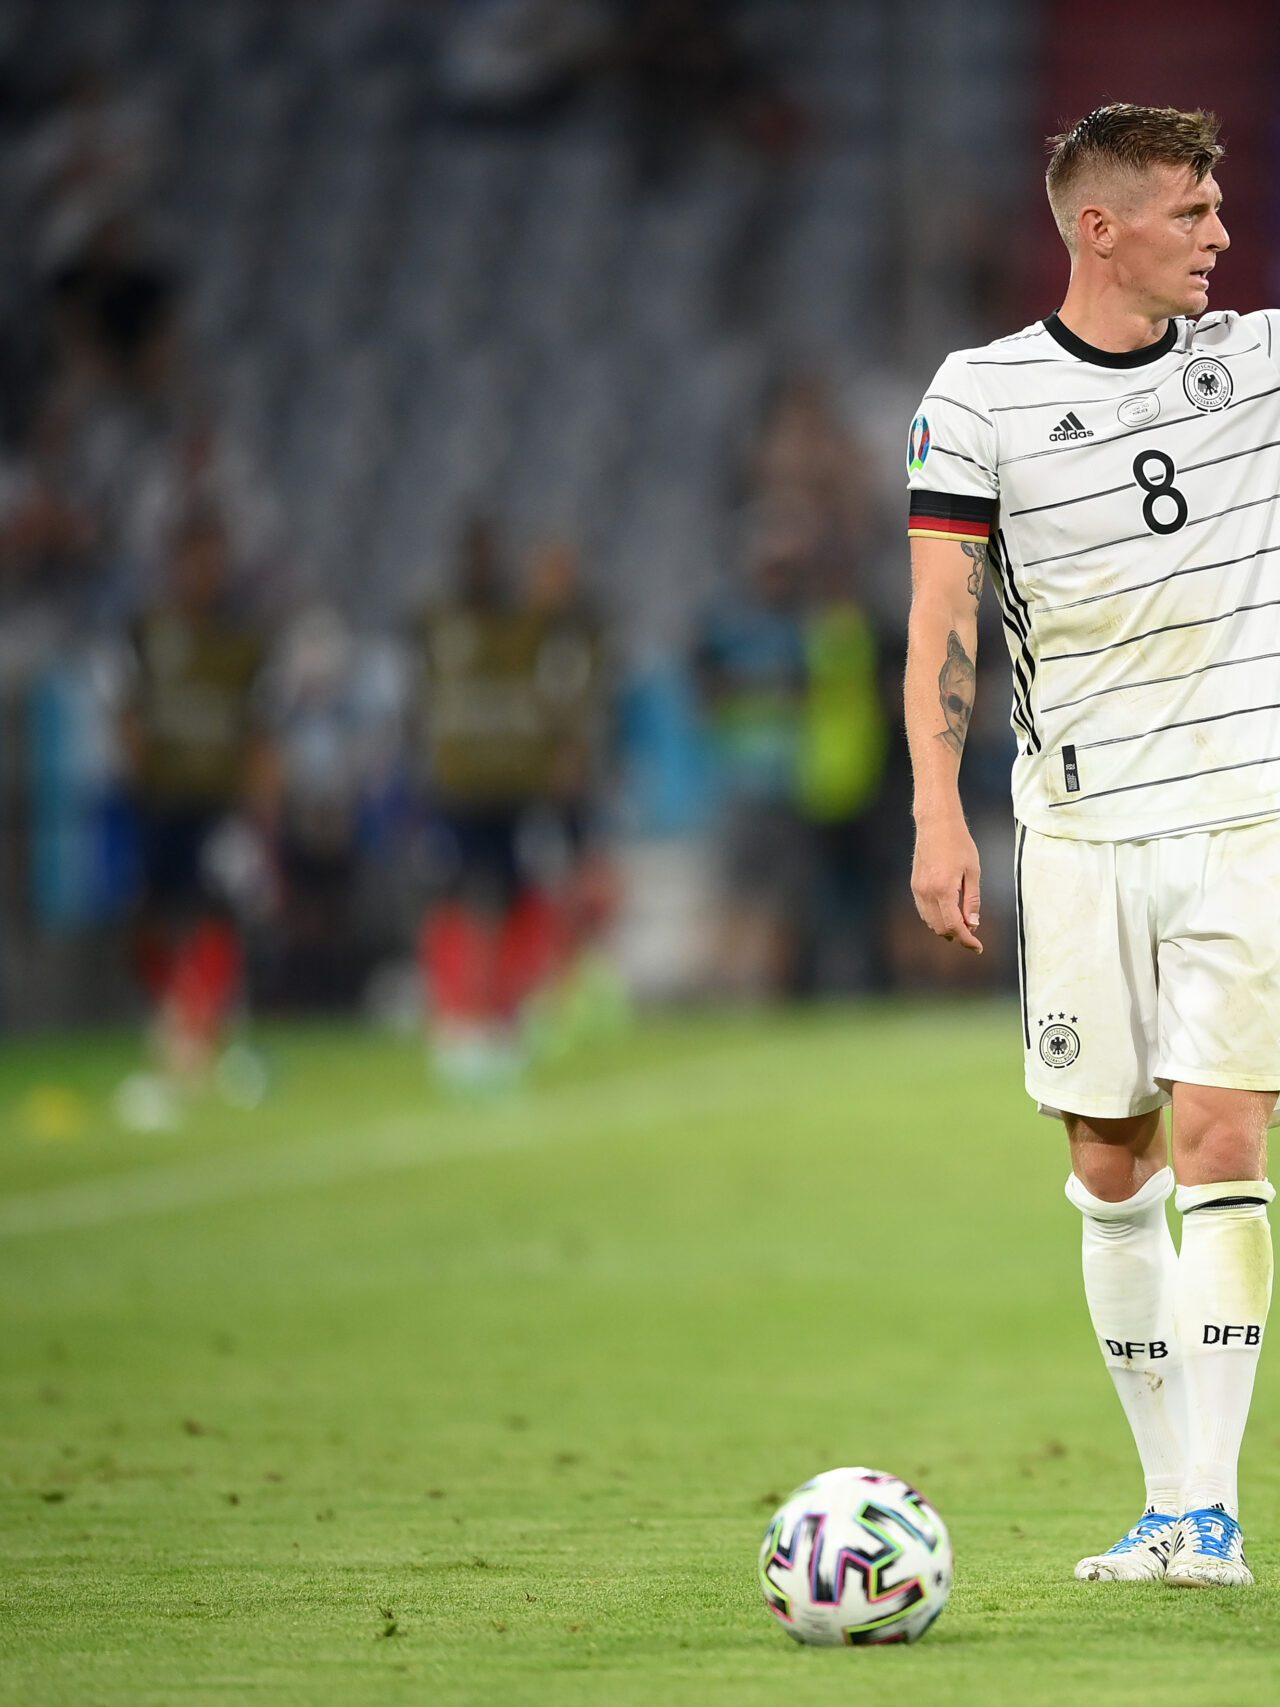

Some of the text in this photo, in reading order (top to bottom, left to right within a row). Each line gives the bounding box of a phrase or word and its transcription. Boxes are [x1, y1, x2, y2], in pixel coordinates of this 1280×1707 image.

[1191, 363, 1218, 378] DEUTSCHER
[1049, 430, 1094, 442] adidas
[1133, 450, 1188, 535] 8
[1202, 1324, 1260, 1346] DFB
[1105, 1339, 1169, 1360] DFB
